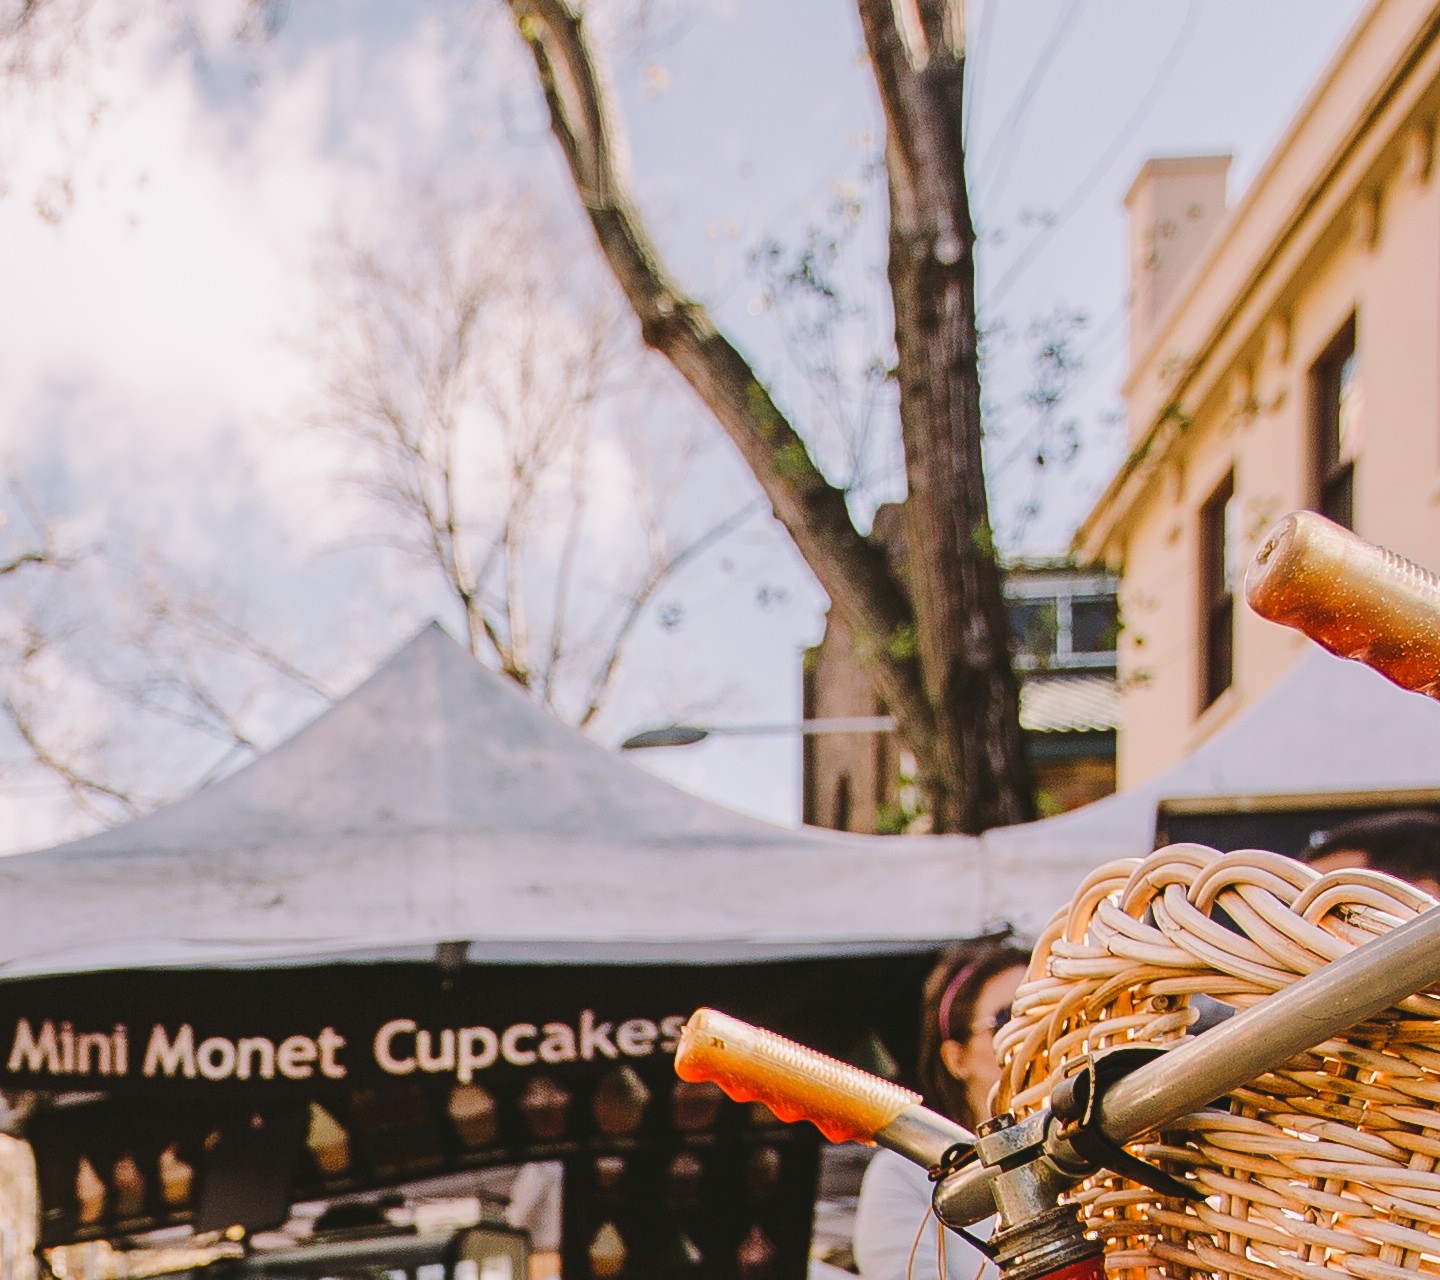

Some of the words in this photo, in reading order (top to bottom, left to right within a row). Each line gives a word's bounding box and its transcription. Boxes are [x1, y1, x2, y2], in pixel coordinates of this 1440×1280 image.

[7, 1017, 128, 1076] Mini
[142, 1022, 348, 1081] Monet
[373, 1008, 688, 1085] Cupcakes
